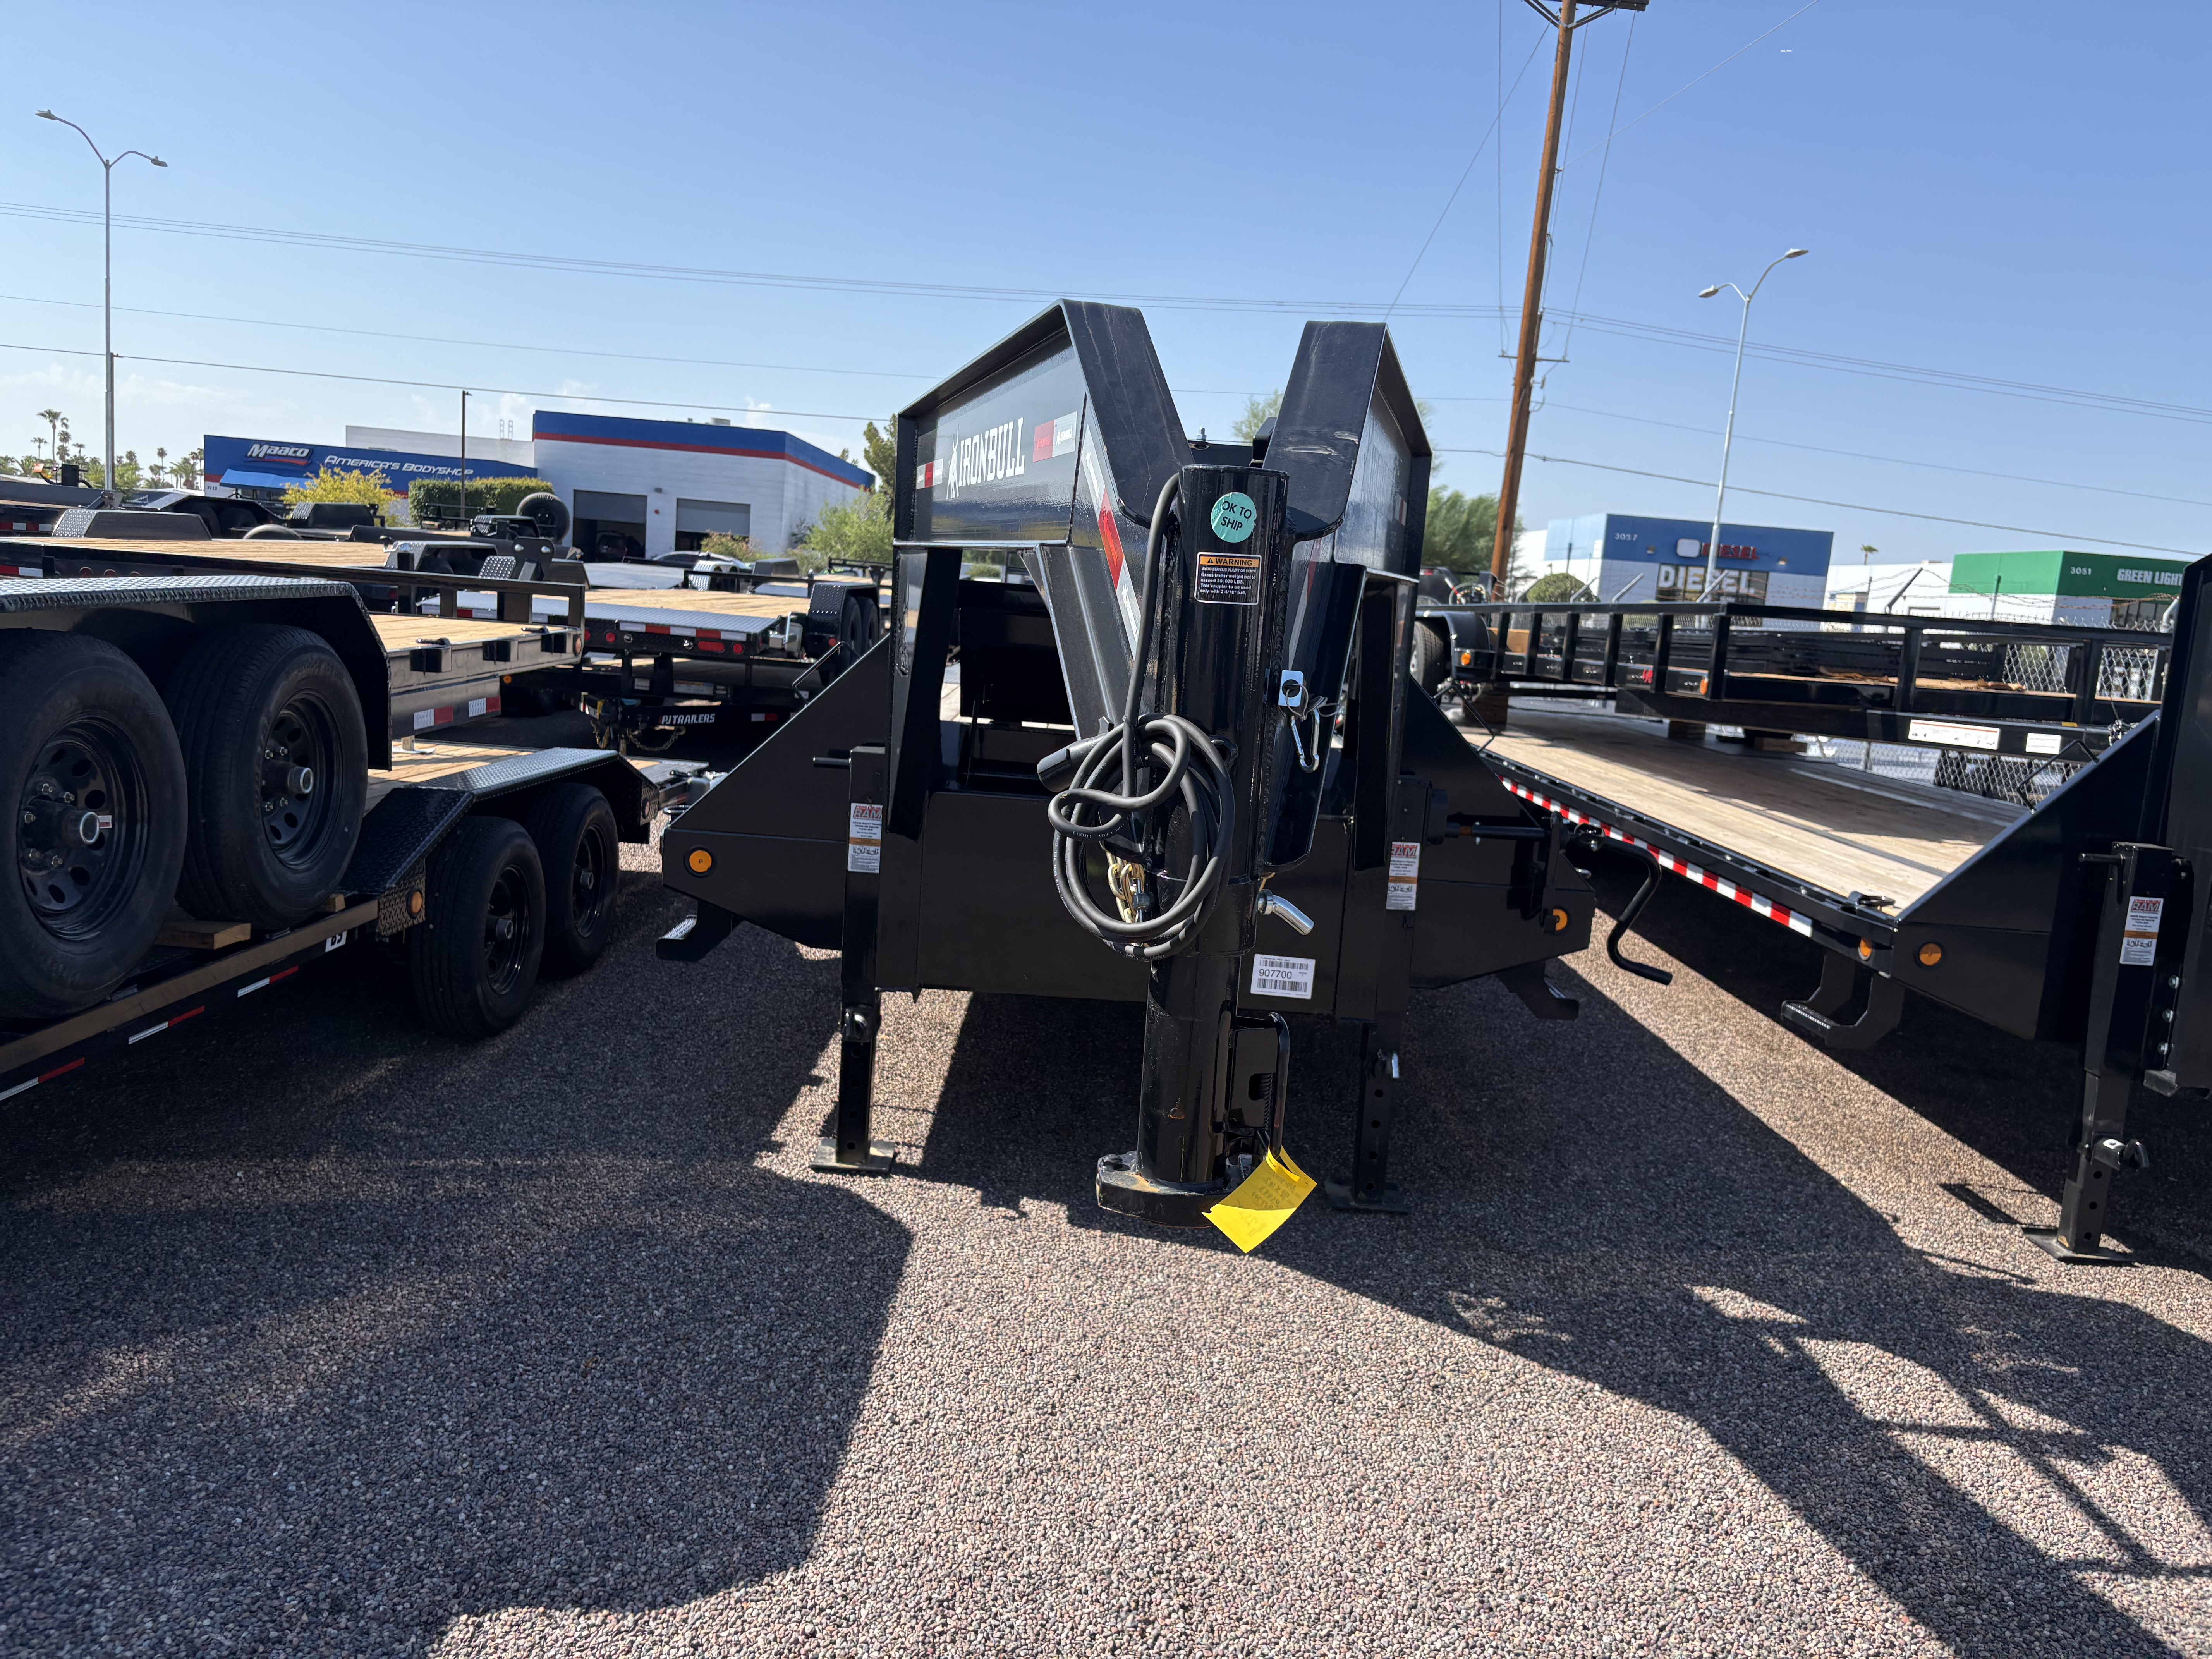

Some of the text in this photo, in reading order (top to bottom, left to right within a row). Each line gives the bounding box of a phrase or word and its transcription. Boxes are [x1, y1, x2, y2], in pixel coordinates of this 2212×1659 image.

[958, 417, 1025, 487] IRONBULL
[1222, 501, 1252, 519] OK TO
[1221, 516, 1243, 531] SHIP
[1700, 542, 1760, 559] DESEL
[2117, 568, 2153, 584] GREEN
[671, 713, 715, 725] TRAILERS
[853, 809, 882, 818] RAM
[2131, 902, 2160, 912] RAM
[1259, 969, 1292, 979] 907700
